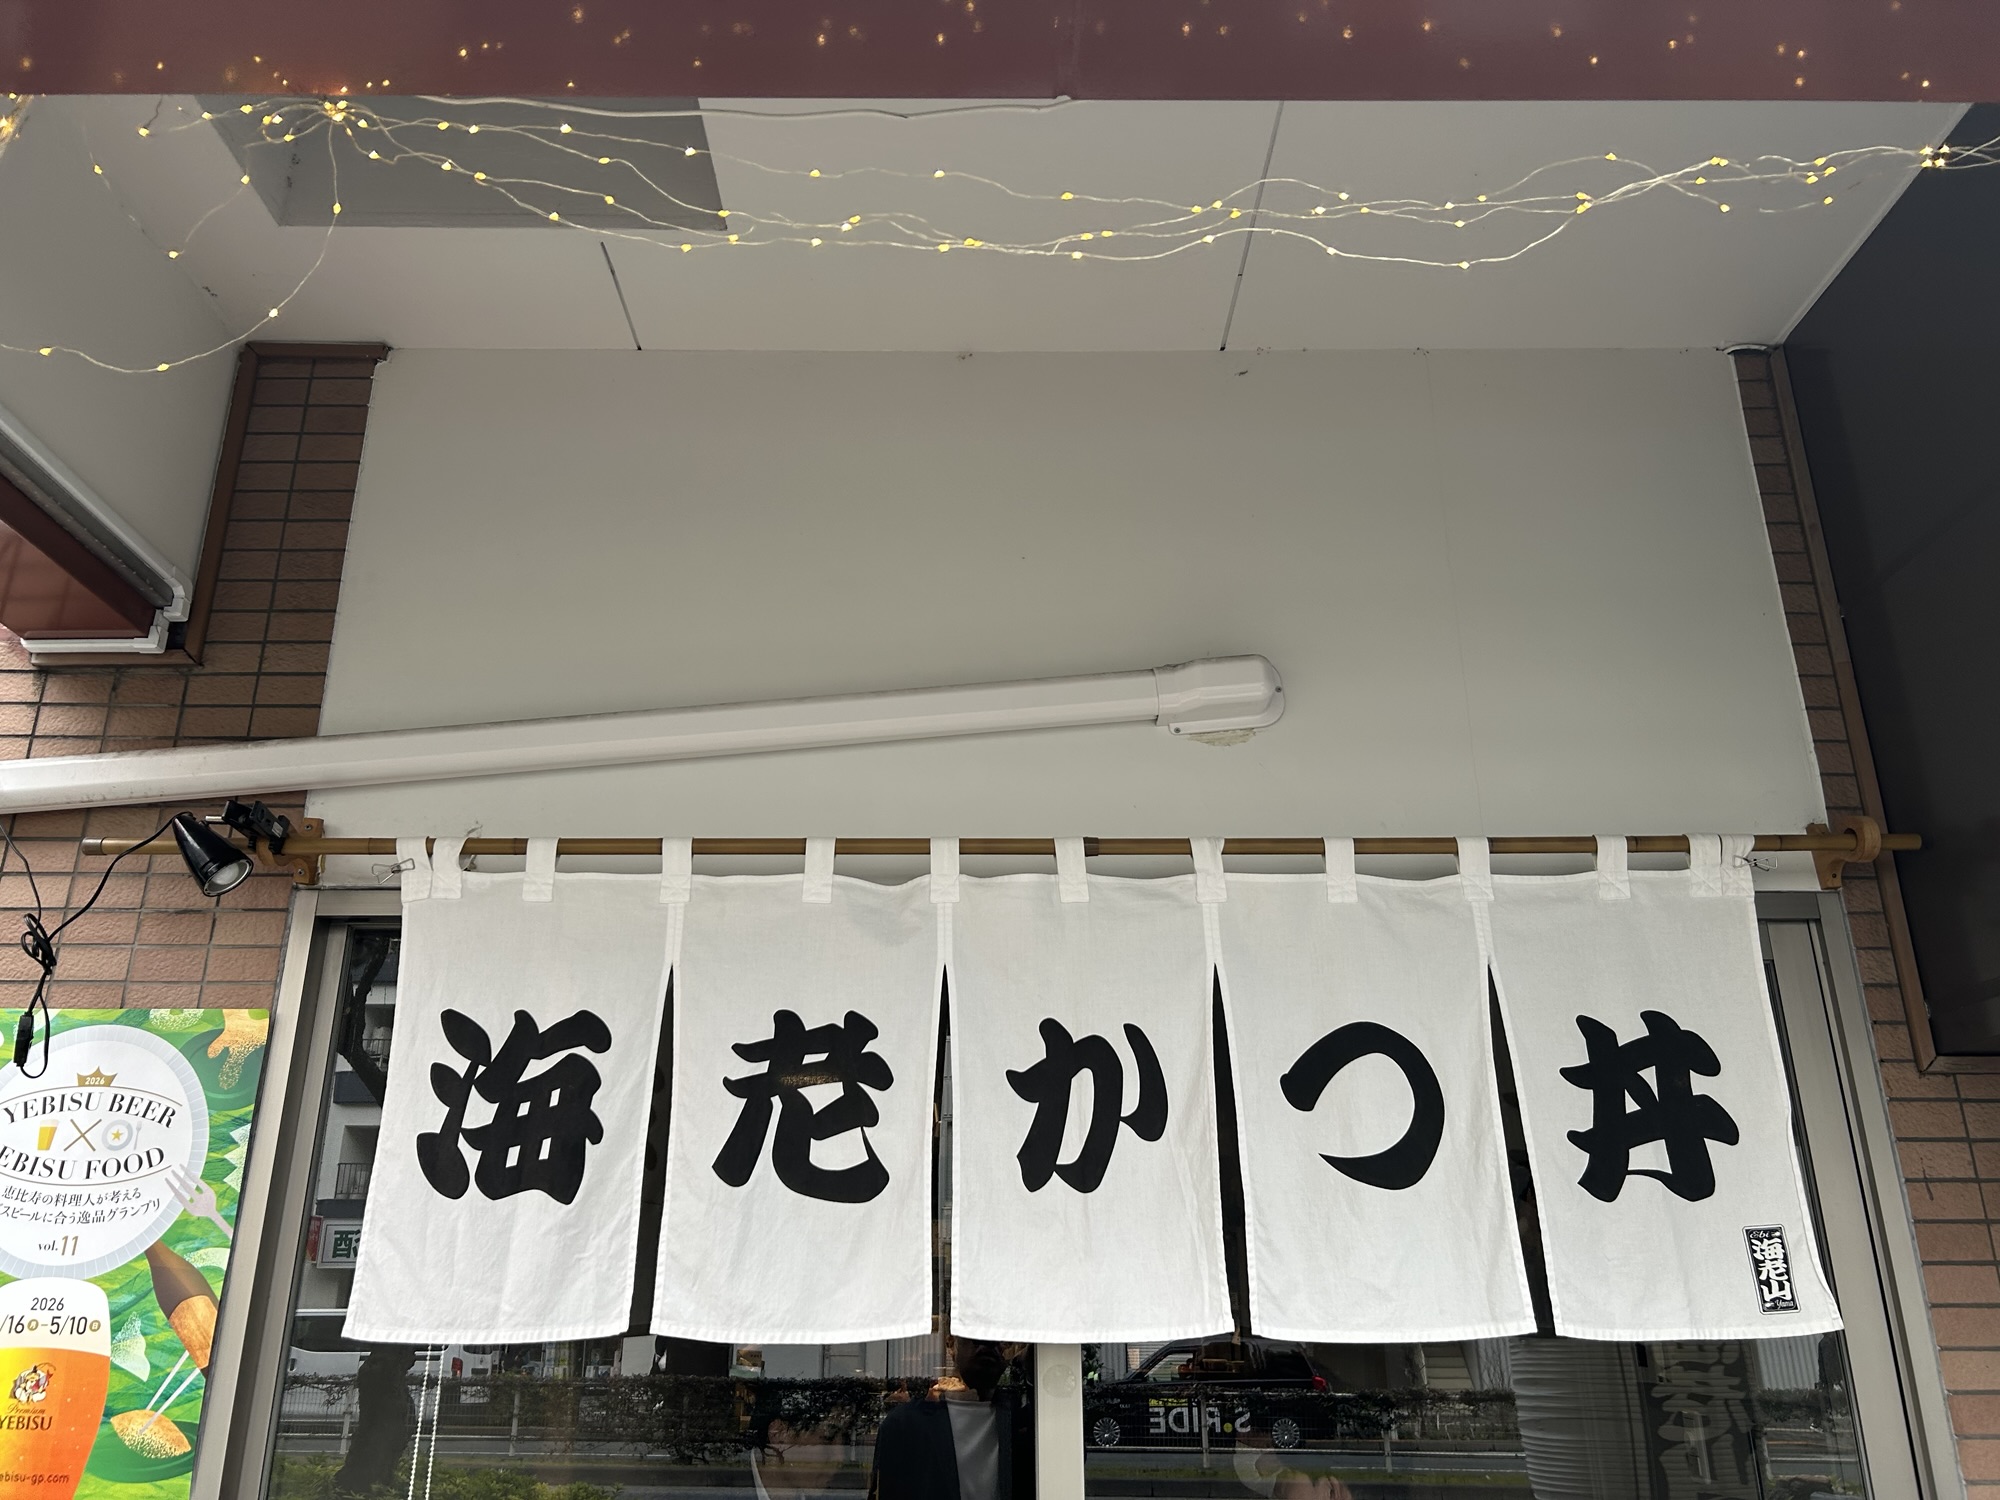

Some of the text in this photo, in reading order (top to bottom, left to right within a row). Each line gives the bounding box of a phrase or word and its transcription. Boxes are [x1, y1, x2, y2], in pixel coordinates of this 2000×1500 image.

[84, 1076, 106, 1085] 2026
[3, 1092, 177, 1129] YEBISU BEER
[416, 1008, 1740, 1205] 海老かつ丼
[83, 1147, 165, 1180] FOOD
[1, 1185, 142, 1207] 恵比寿の料理人が考える
[1751, 1237, 1793, 1302] 海老山
[30, 1297, 65, 1311] 2026
[6, 1403, 46, 1415] Premium
